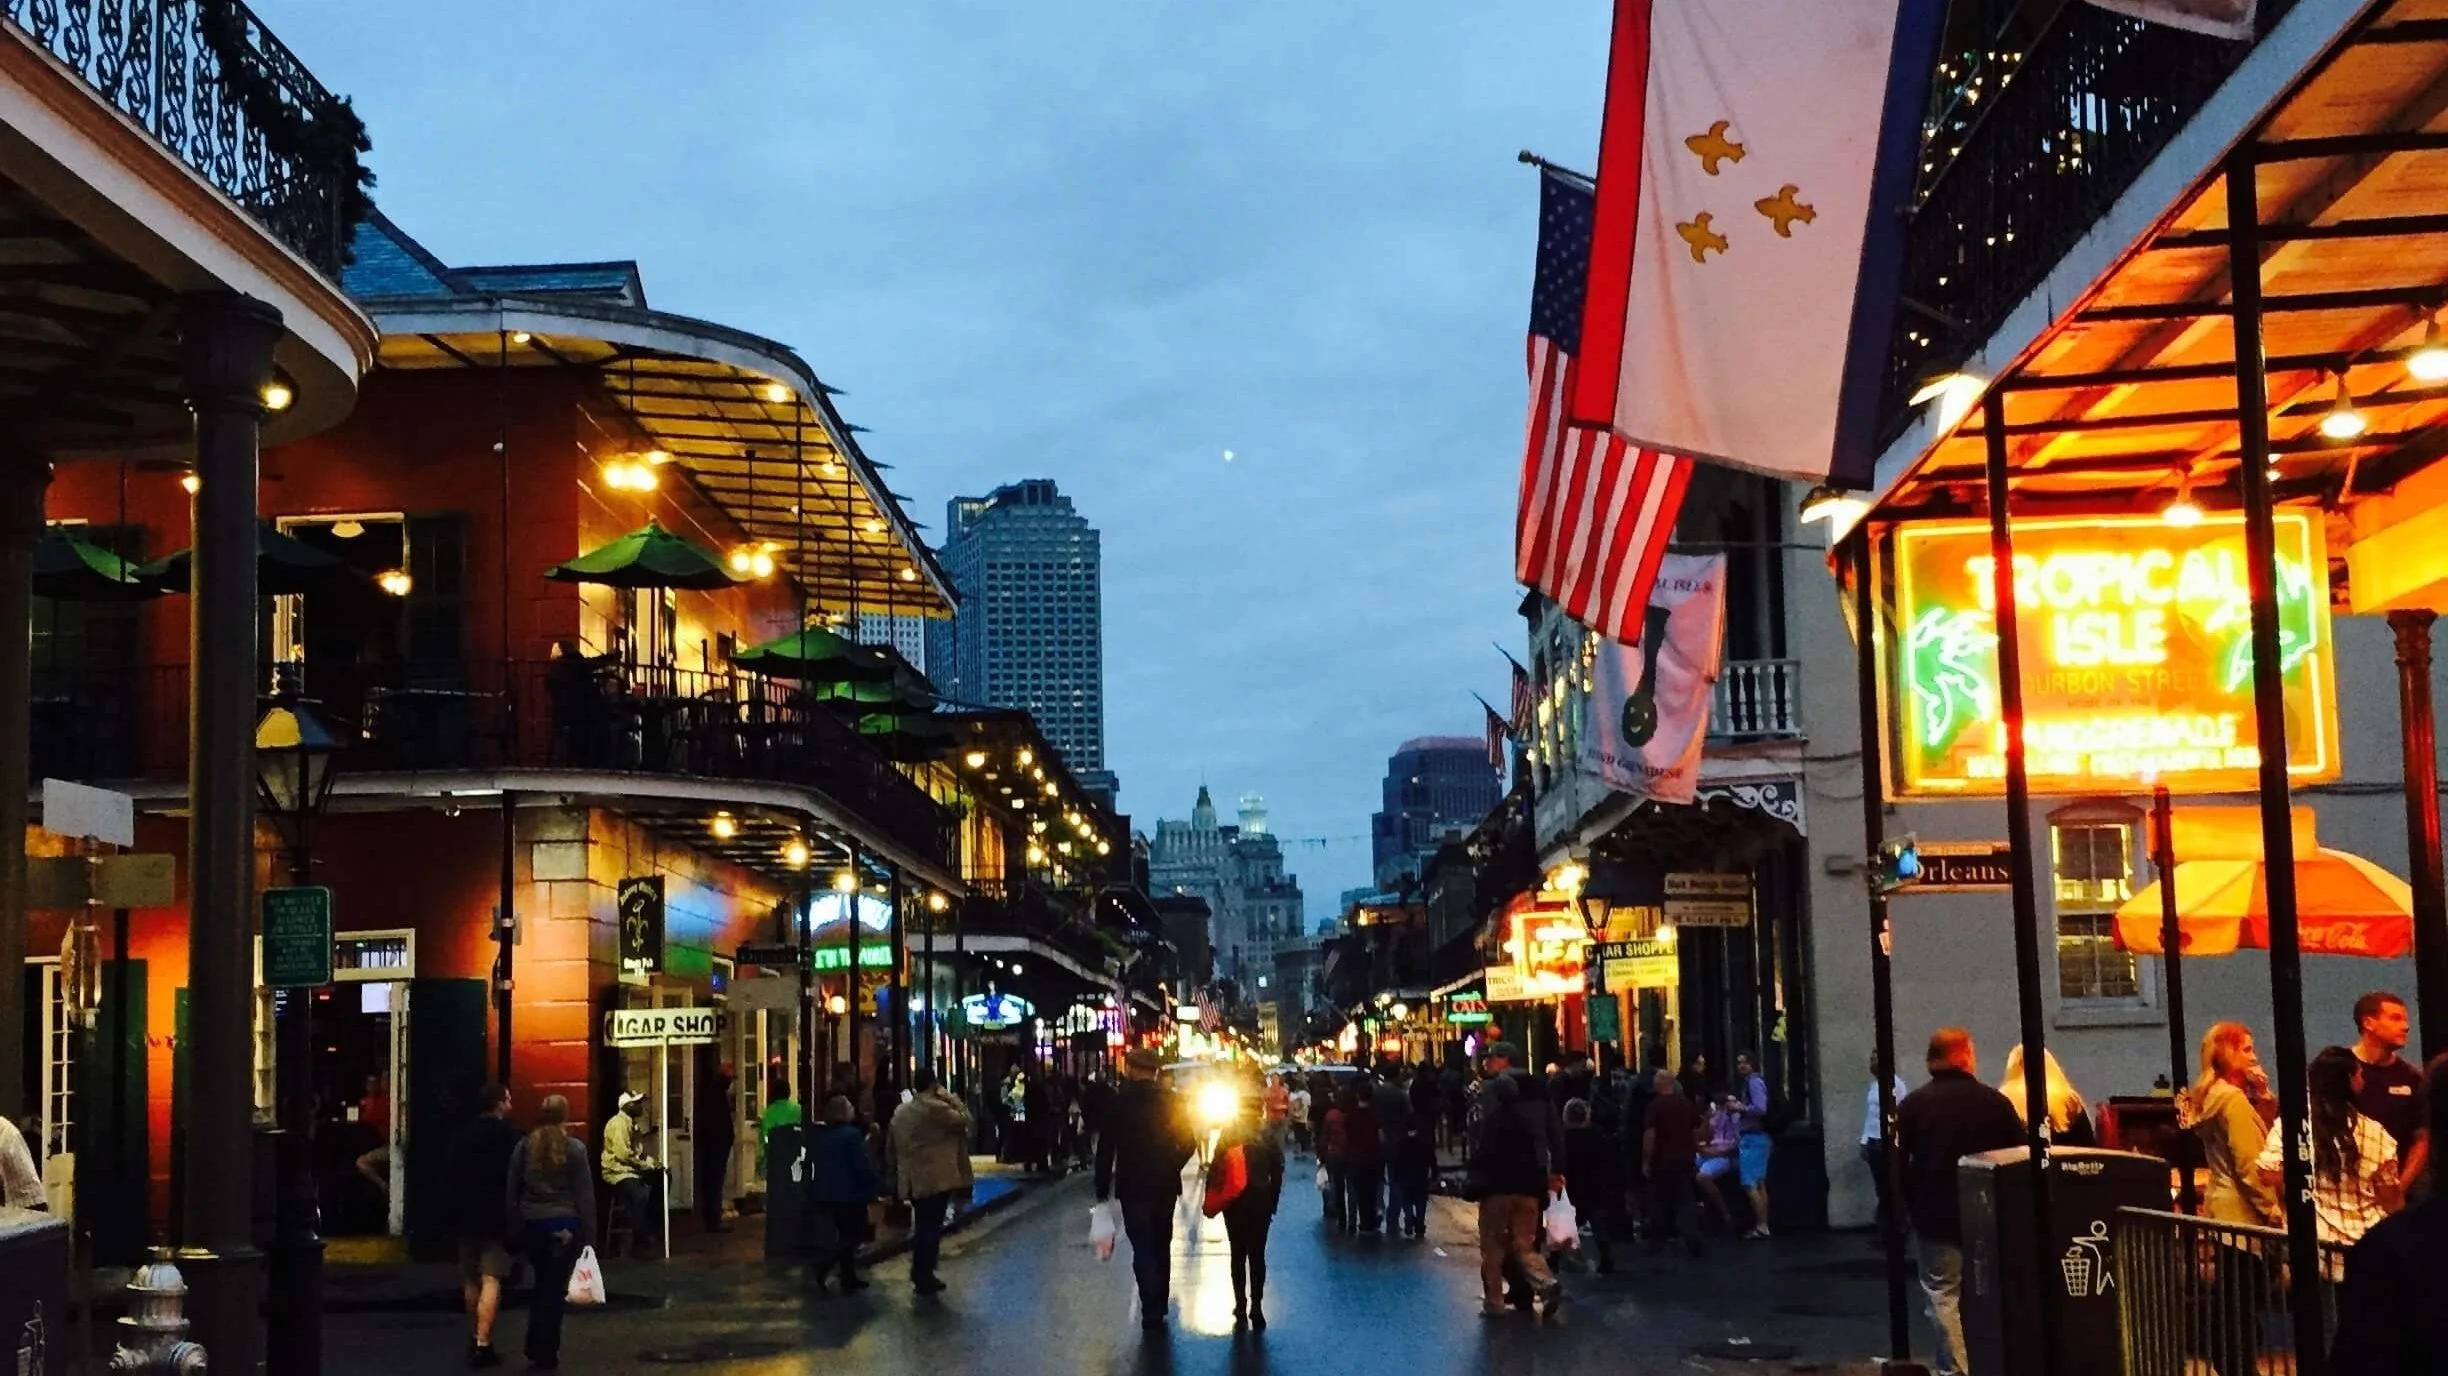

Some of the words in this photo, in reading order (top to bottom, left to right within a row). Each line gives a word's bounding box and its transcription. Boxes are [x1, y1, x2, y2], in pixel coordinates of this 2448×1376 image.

[1966, 551, 2253, 609] TROPICAL
[2055, 611, 2166, 665] ISLE
[2021, 669, 2116, 697] OURBON
[1585, 945, 1622, 961] CAR
[673, 1013, 727, 1037] SHOP
